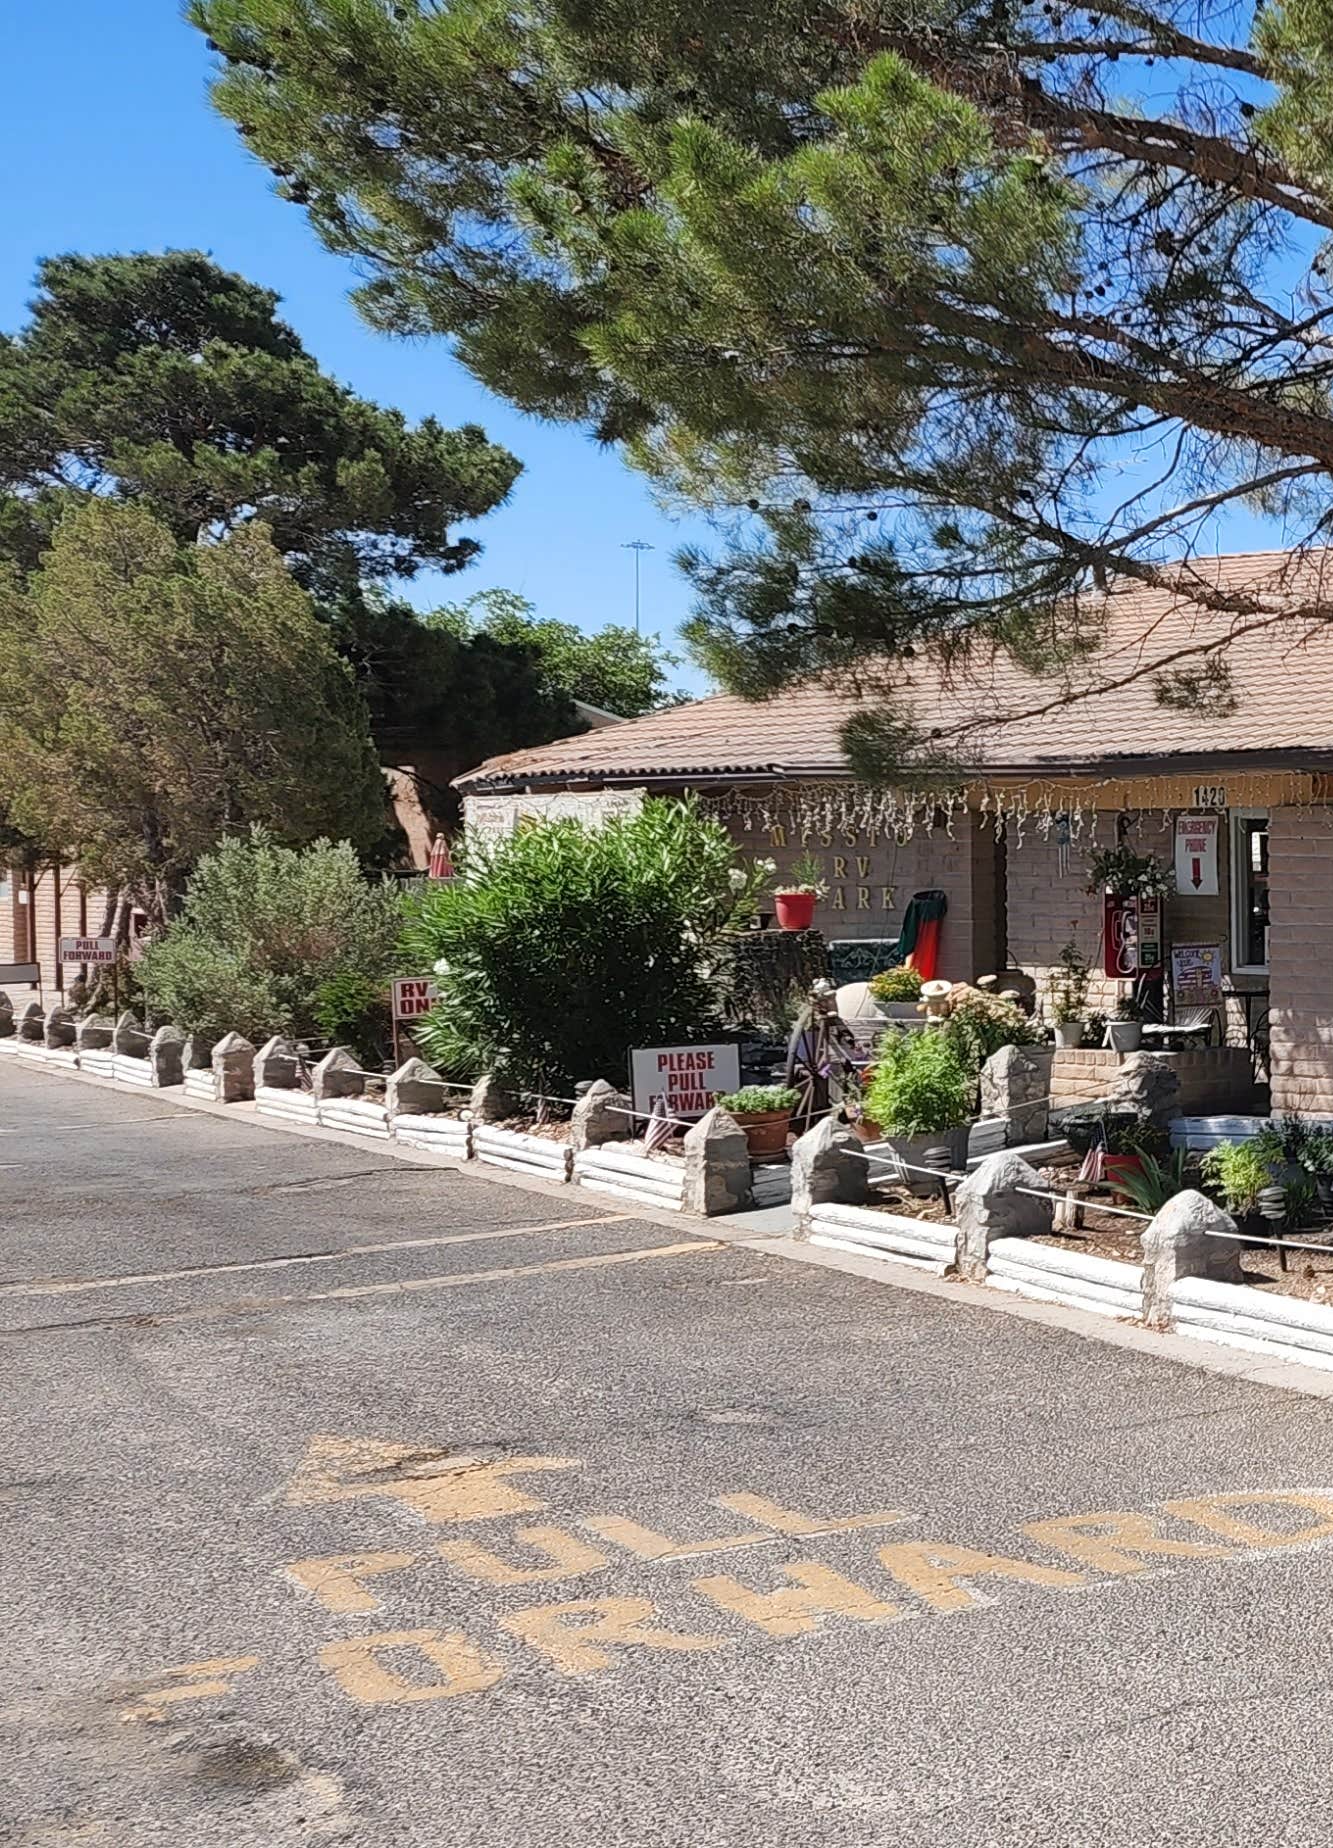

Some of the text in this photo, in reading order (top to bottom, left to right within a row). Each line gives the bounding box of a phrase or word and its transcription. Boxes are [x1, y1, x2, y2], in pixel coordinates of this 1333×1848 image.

[1194, 786, 1226, 806] 1420
[833, 856, 869, 878] RV
[75, 940, 99, 950] PULL
[63, 950, 112, 961] FORWARD
[401, 982, 428, 998] RV
[657, 1051, 714, 1072] PLEASE
[668, 1072, 706, 1091] PULL
[282, 1492, 918, 1614] PULL
